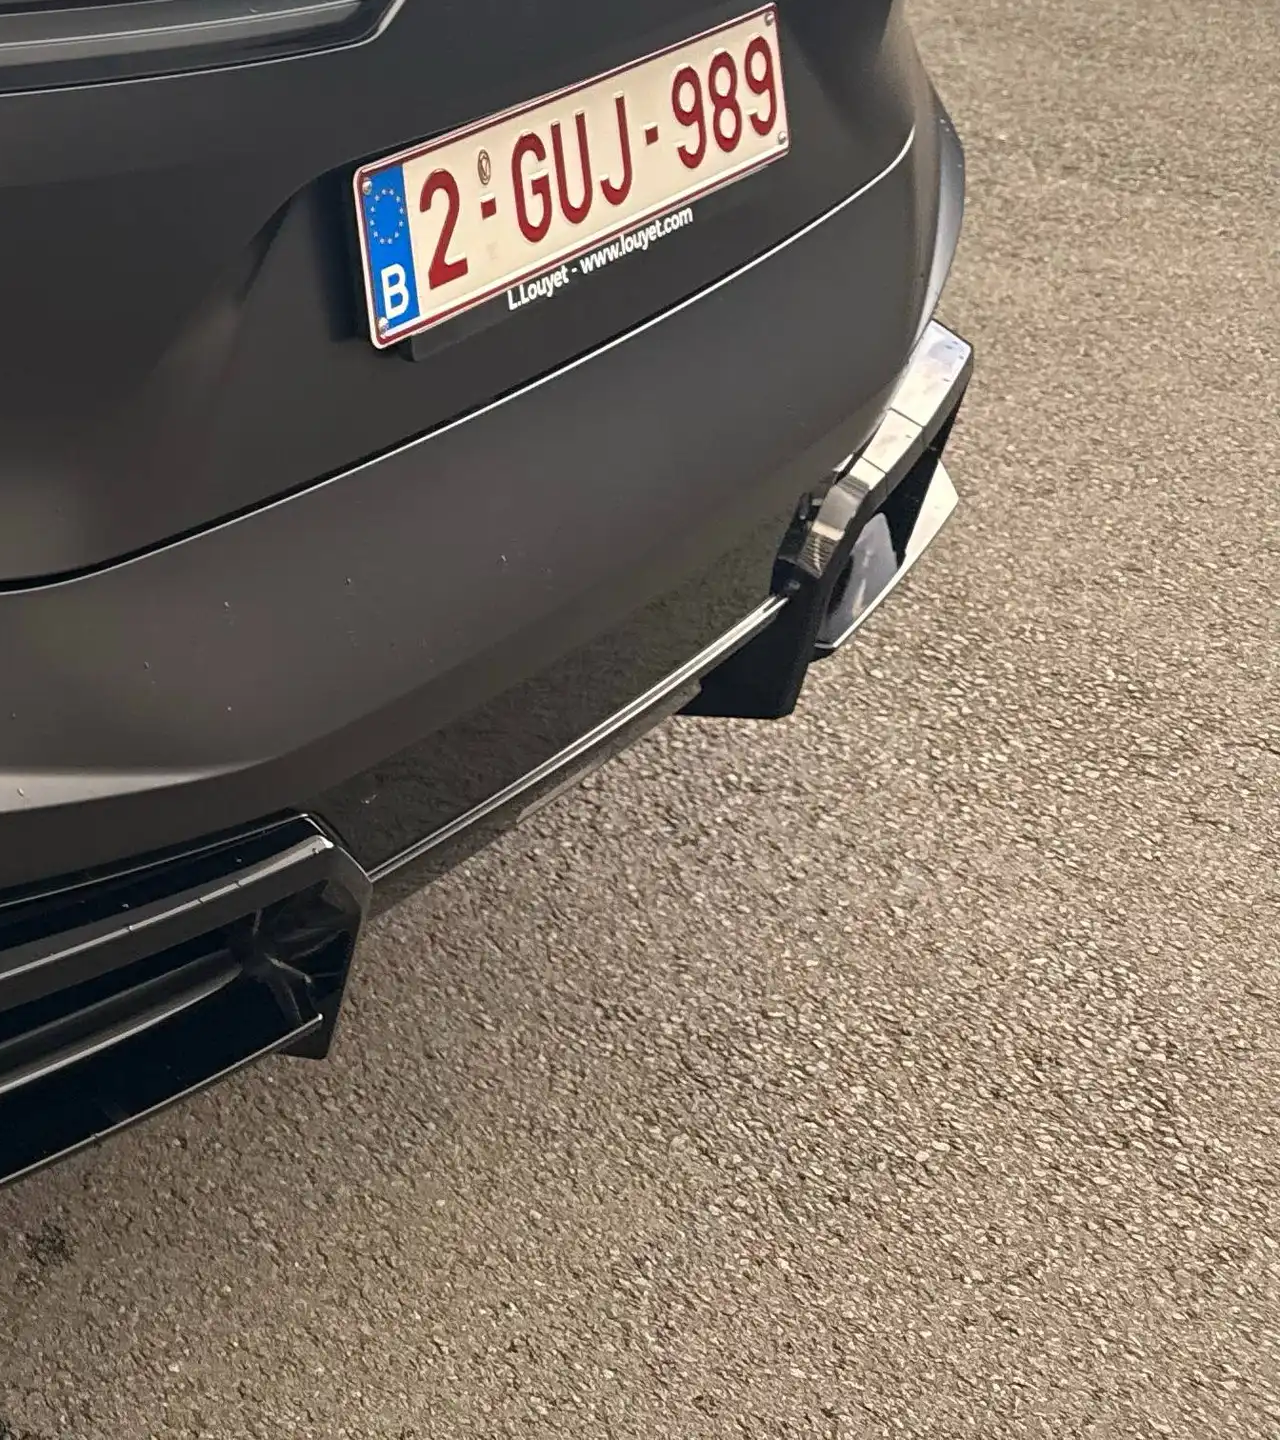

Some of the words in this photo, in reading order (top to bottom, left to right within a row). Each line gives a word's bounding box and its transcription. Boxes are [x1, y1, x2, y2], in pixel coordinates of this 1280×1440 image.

[419, 35, 776, 291] 2-GUJ-989
[380, 264, 410, 320] B
[507, 265, 569, 310] L.Louyet
[579, 207, 693, 274] www.louyet.com
